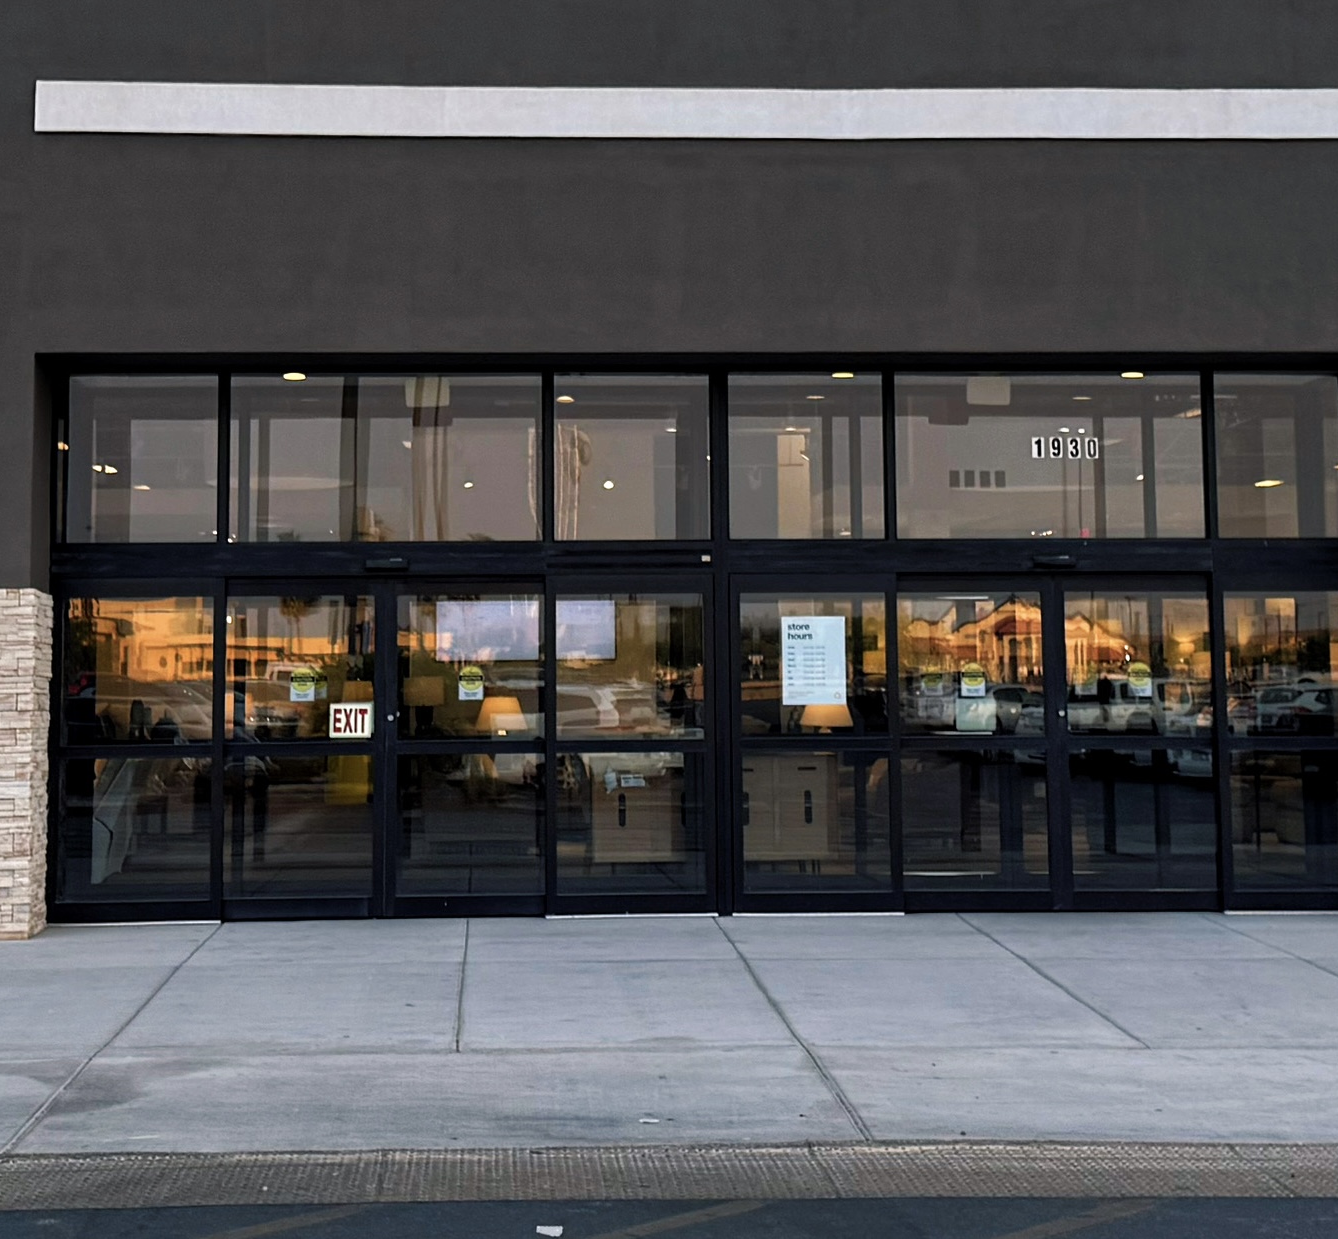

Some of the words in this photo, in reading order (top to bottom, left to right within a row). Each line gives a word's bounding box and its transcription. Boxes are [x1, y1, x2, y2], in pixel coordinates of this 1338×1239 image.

[1034, 437, 1098, 458] 1930
[787, 623, 810, 631] store
[787, 632, 813, 640] hours
[333, 708, 368, 734] EXIT
